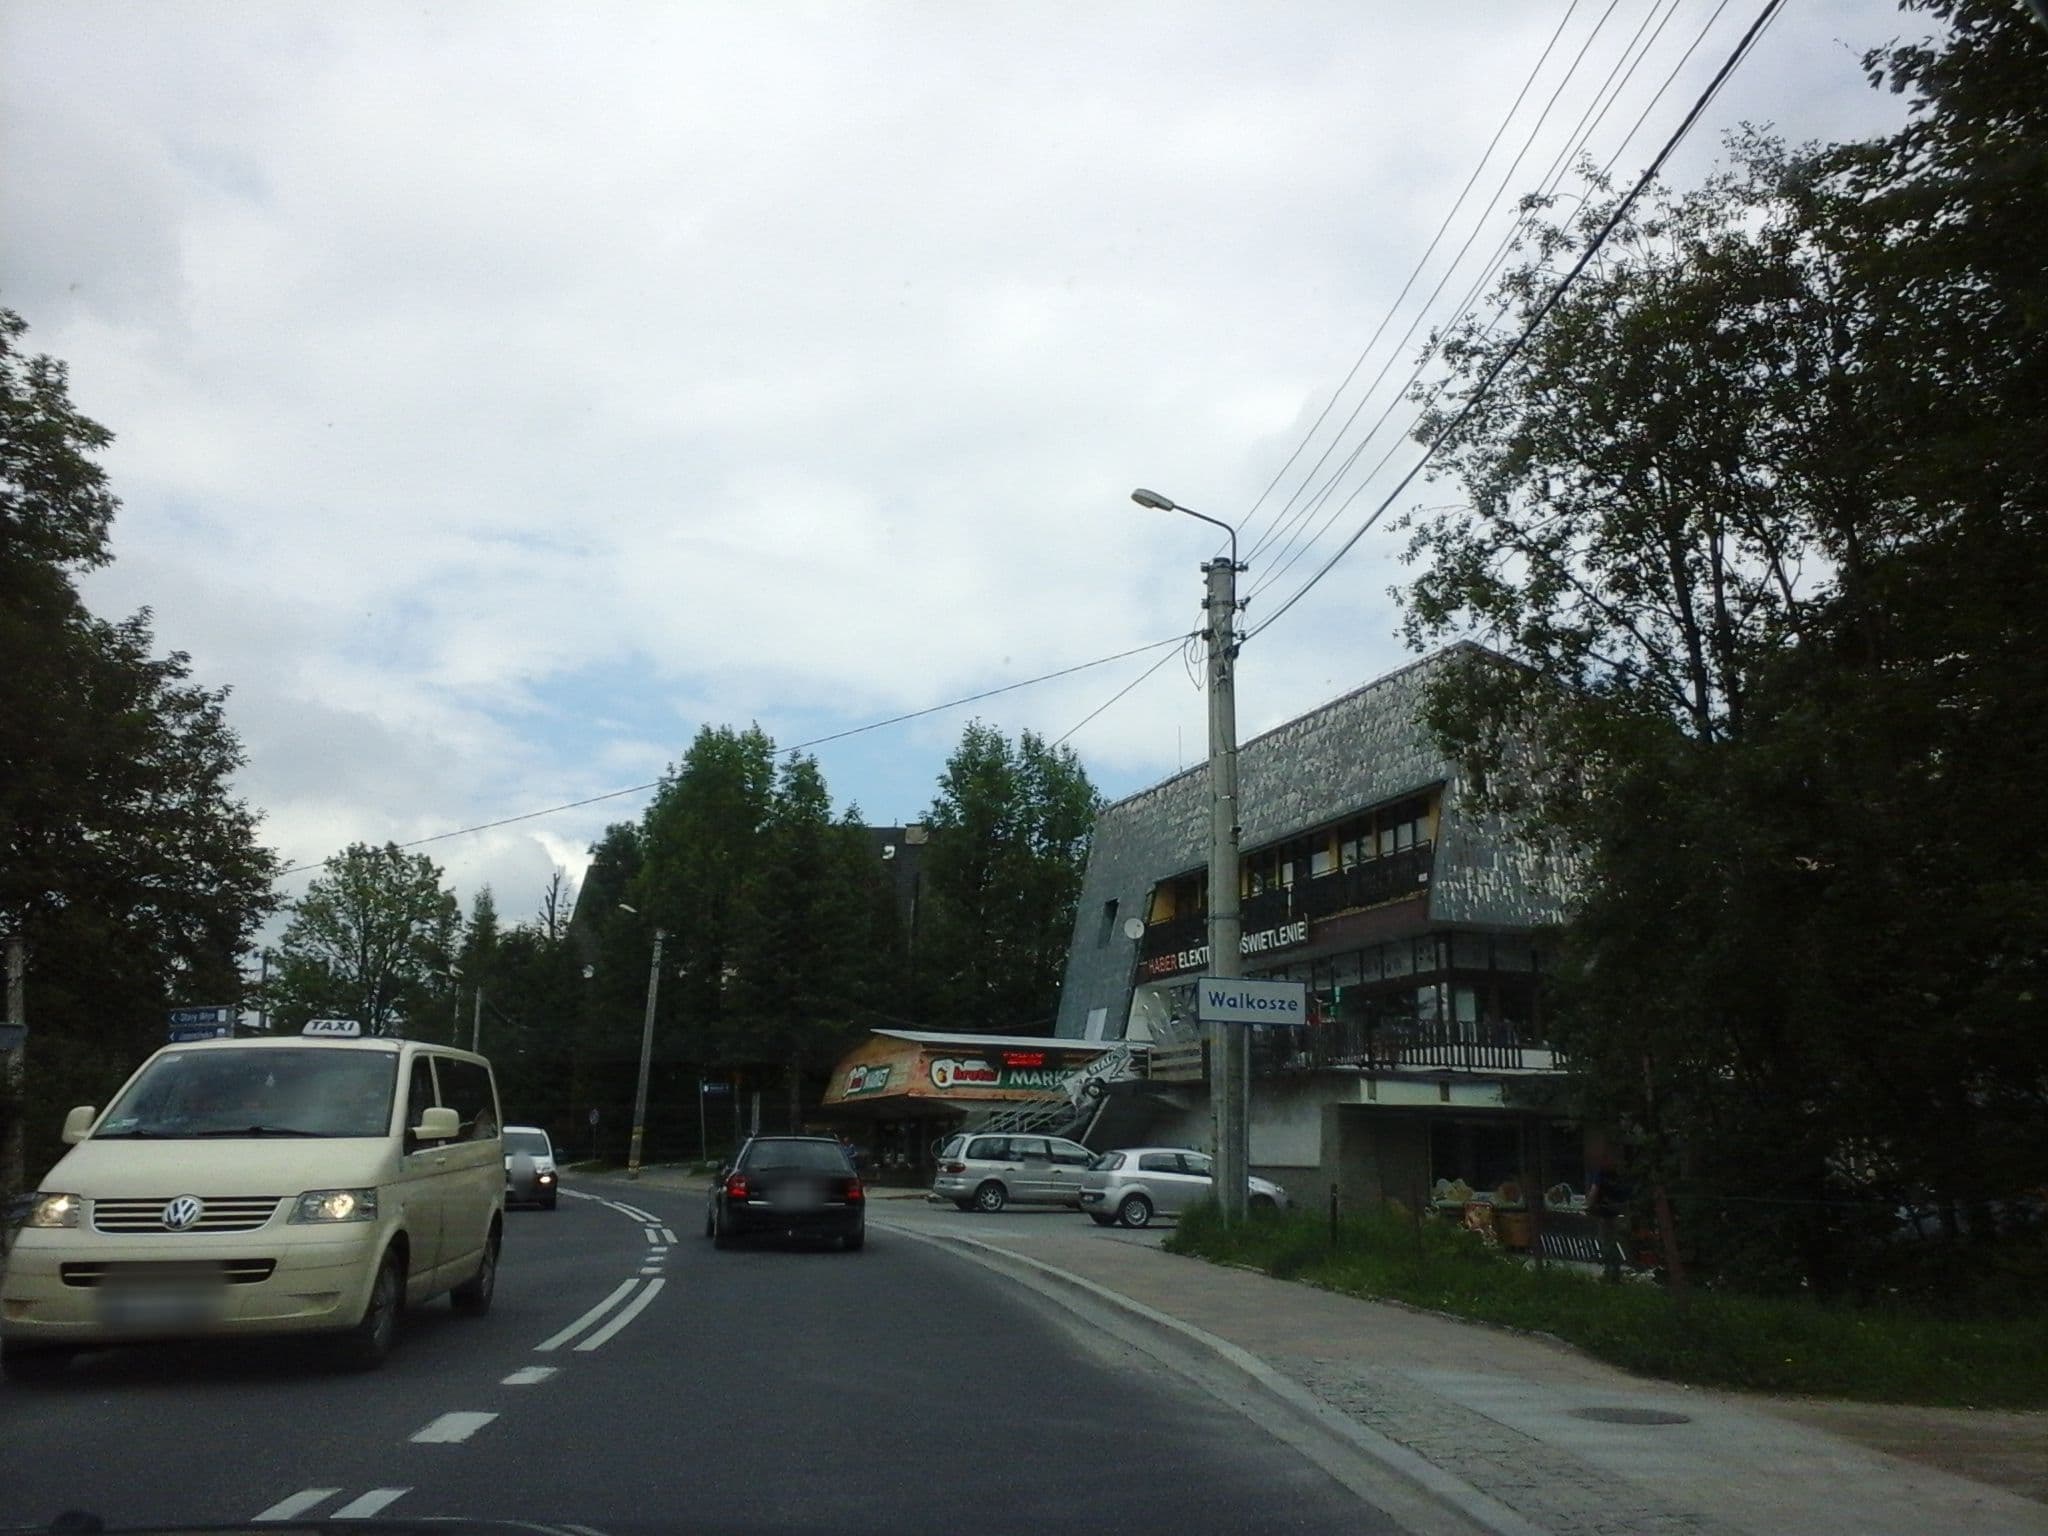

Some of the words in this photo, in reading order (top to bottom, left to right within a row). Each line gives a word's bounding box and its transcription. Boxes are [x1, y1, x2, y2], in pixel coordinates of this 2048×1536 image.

[1239, 921, 1306, 954] ŚWIETLENIE
[1208, 991, 1298, 1011] Walkosze
[311, 1021, 355, 1031] TAXI
